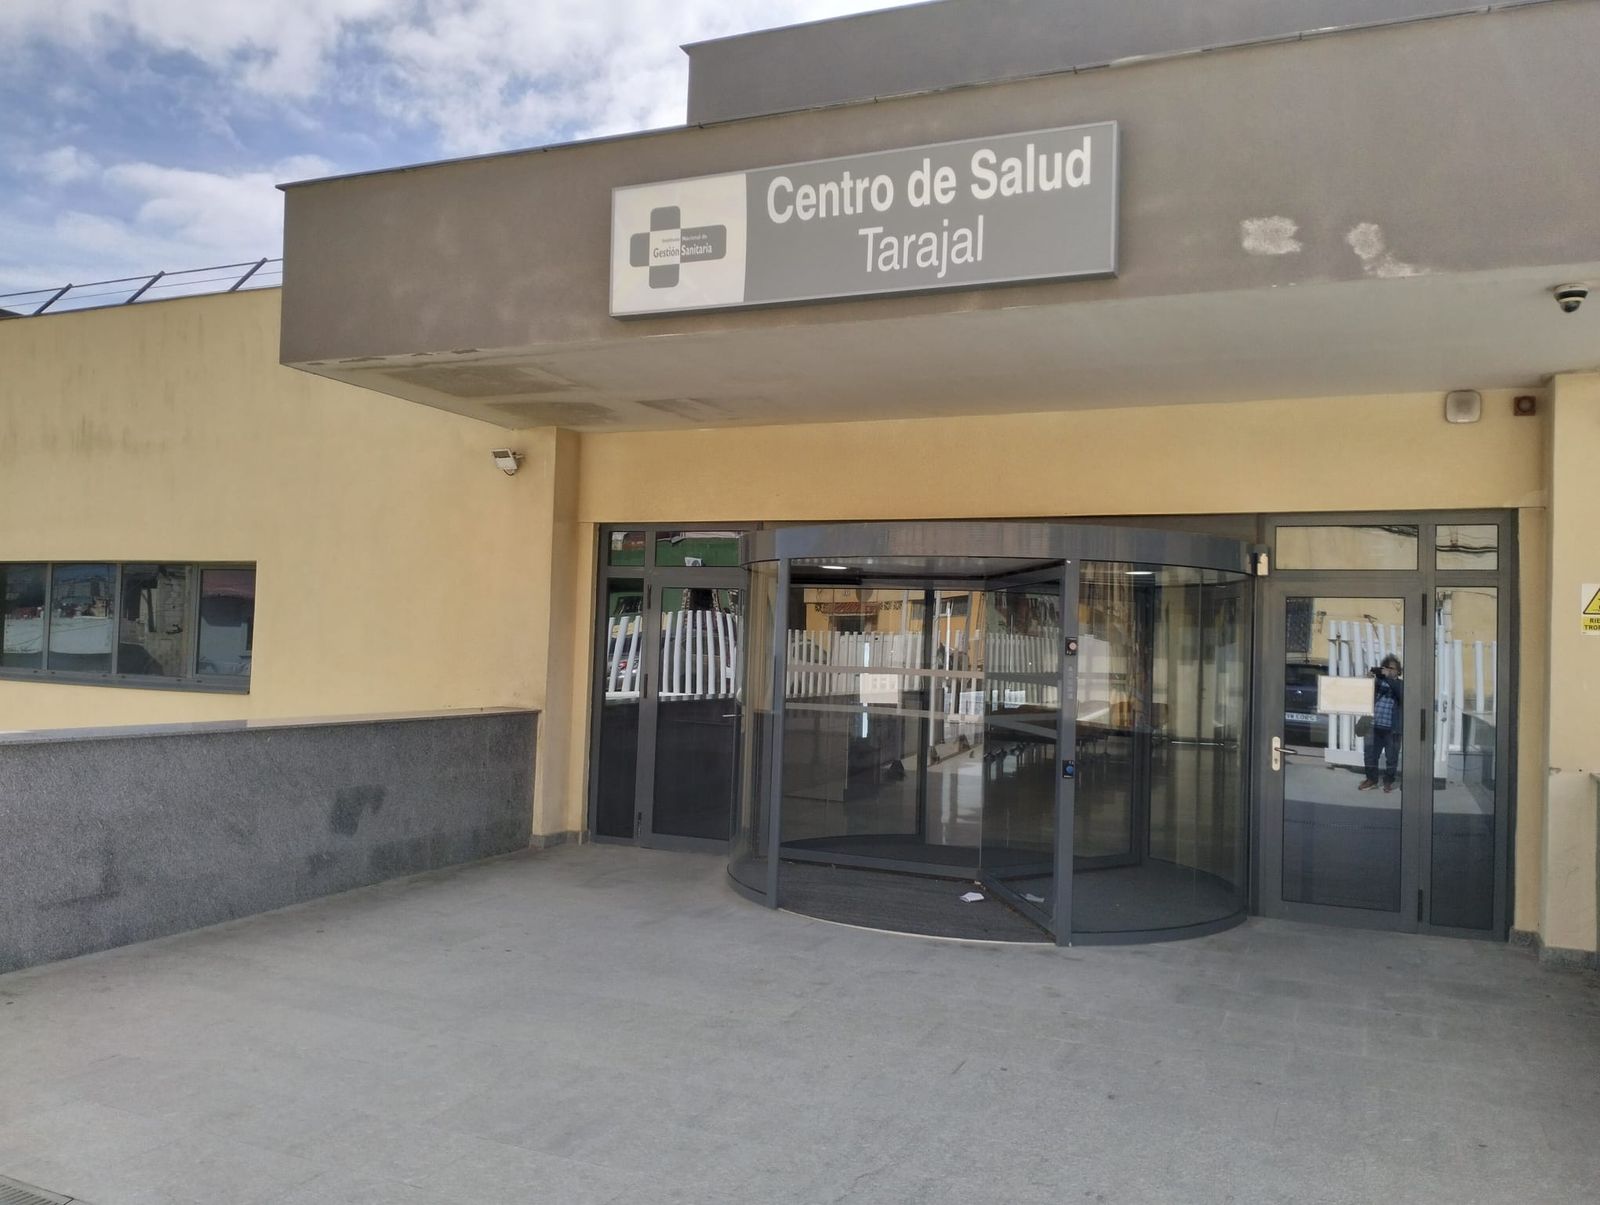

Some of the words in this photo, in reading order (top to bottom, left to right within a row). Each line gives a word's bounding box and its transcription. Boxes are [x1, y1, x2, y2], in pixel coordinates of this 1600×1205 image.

[767, 171, 894, 224] Centro
[907, 158, 957, 208] de
[970, 136, 1092, 200] Salud
[653, 246, 680, 258] Gestión
[680, 242, 712, 256] Sanitaria
[858, 214, 984, 279] Tarajal
